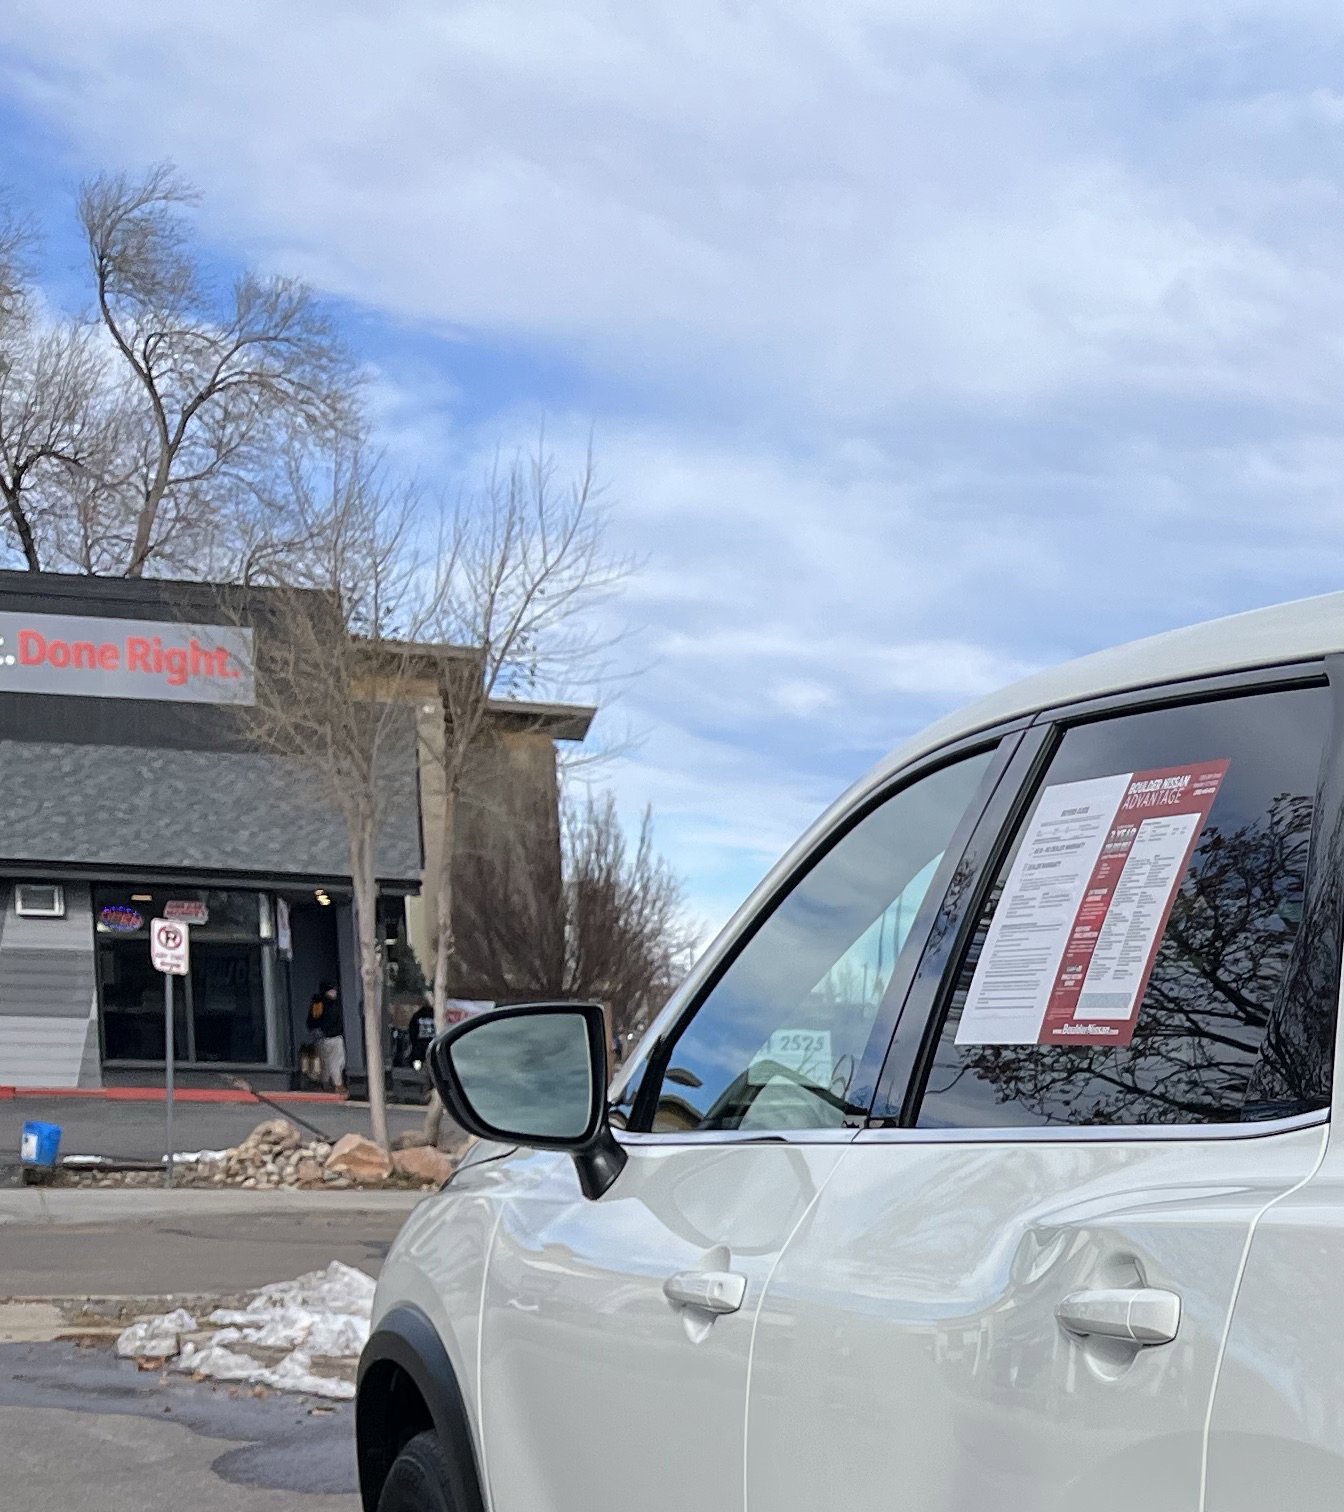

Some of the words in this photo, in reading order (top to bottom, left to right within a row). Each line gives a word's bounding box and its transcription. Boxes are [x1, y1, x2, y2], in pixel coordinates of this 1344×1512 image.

[18, 629, 119, 671] Done
[127, 636, 240, 686] Right.
[1122, 786, 1185, 810] ADVANTAGE
